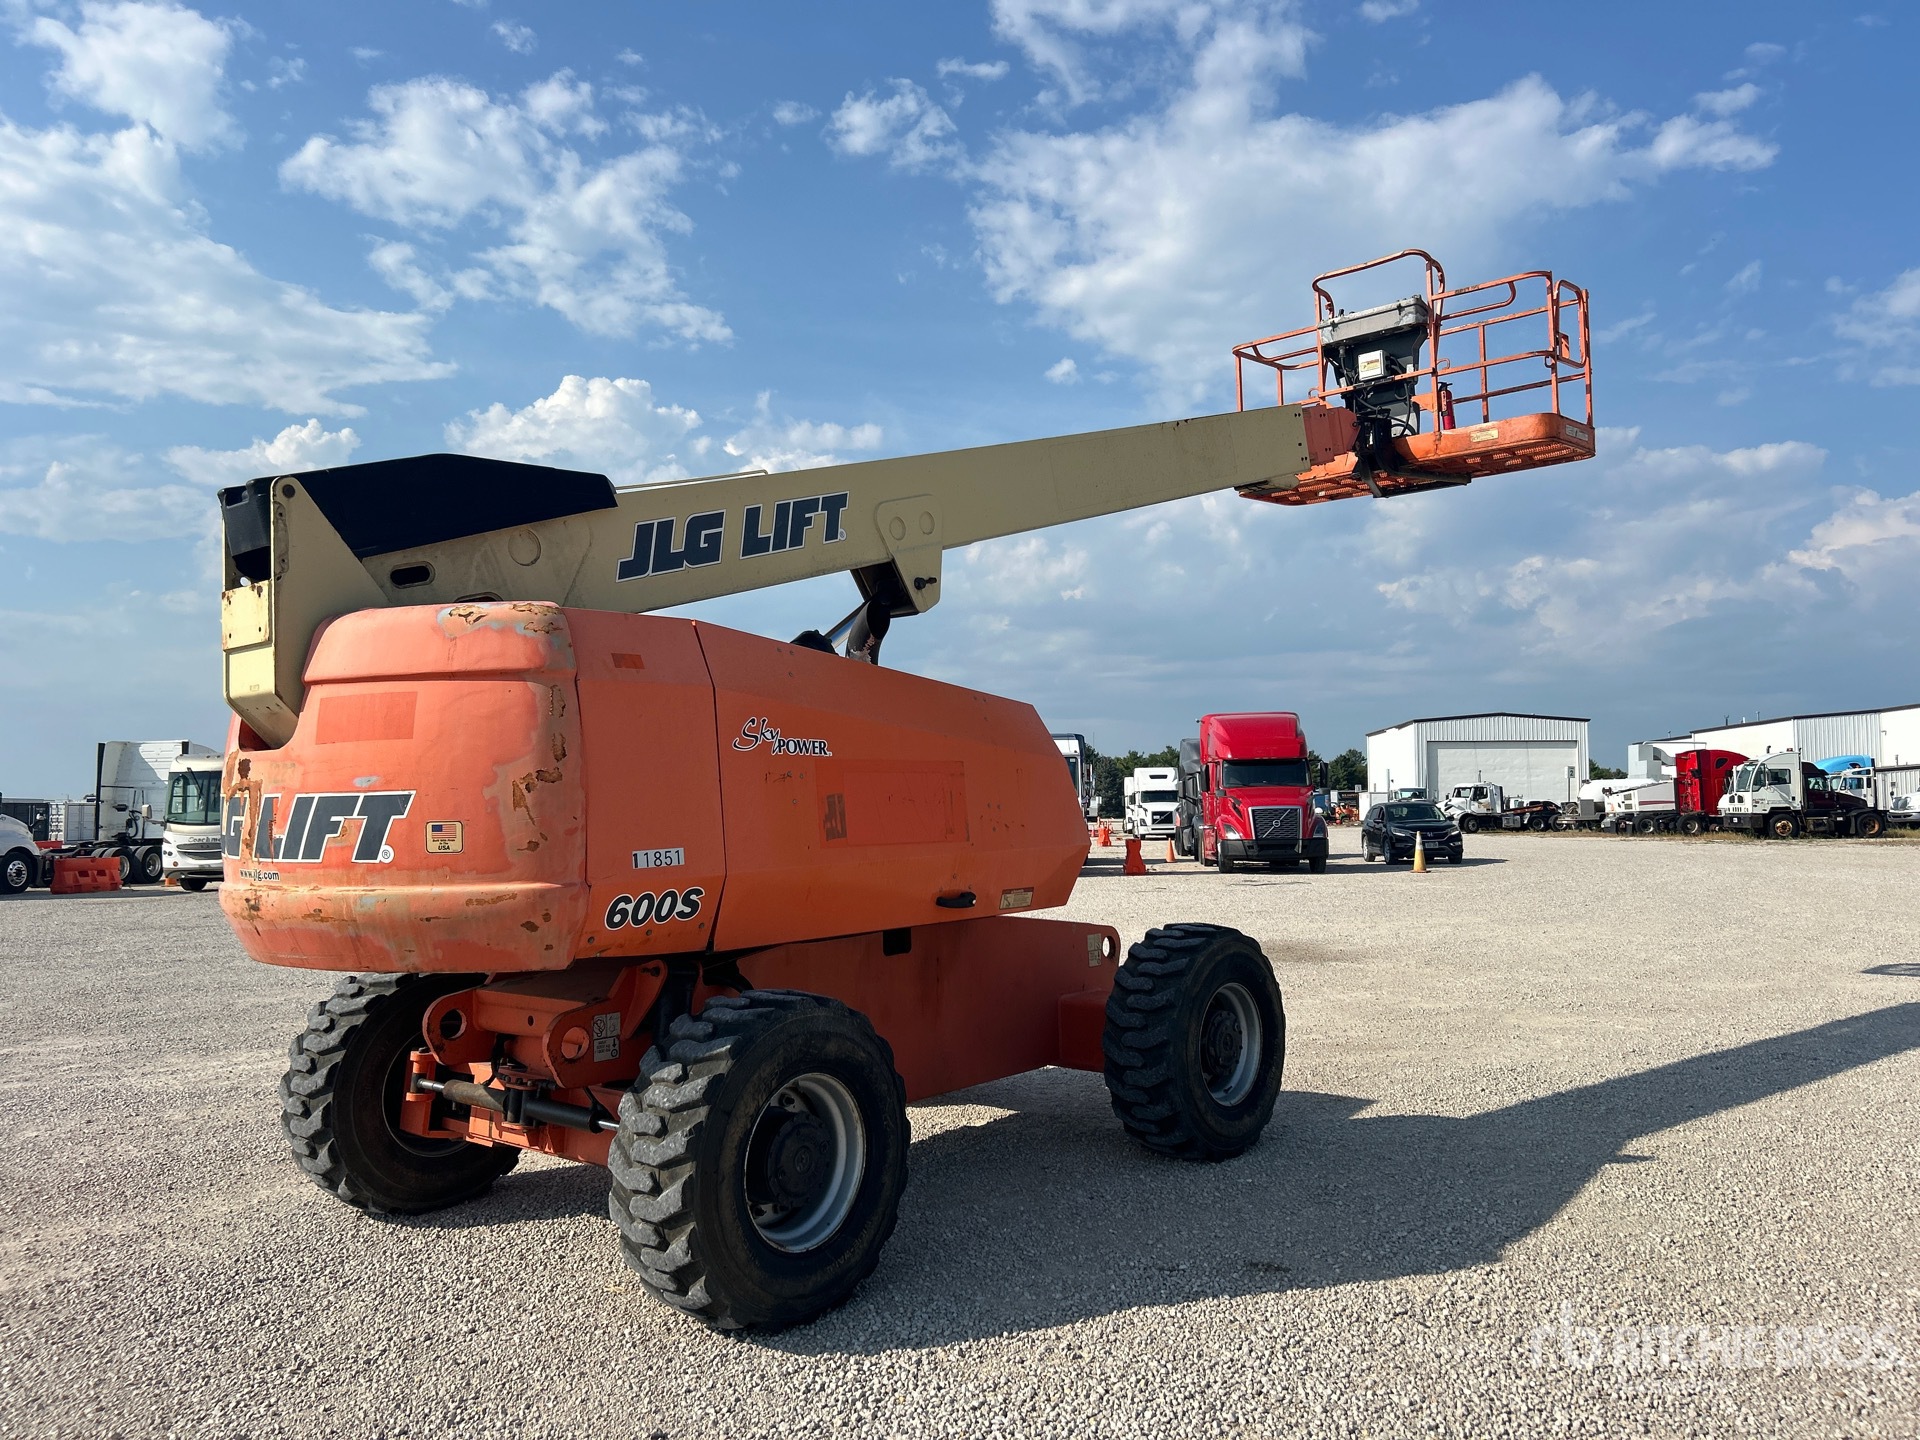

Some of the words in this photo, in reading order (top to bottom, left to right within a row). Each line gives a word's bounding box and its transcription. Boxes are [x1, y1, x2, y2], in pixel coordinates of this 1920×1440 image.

[616, 509, 726, 582] JLG
[740, 491, 849, 559] LIFT
[732, 717, 780, 755] Sky
[777, 738, 828, 756] POWER
[252, 790, 416, 863] LIFT
[632, 849, 682, 869] 11851
[604, 886, 706, 931] 600S
